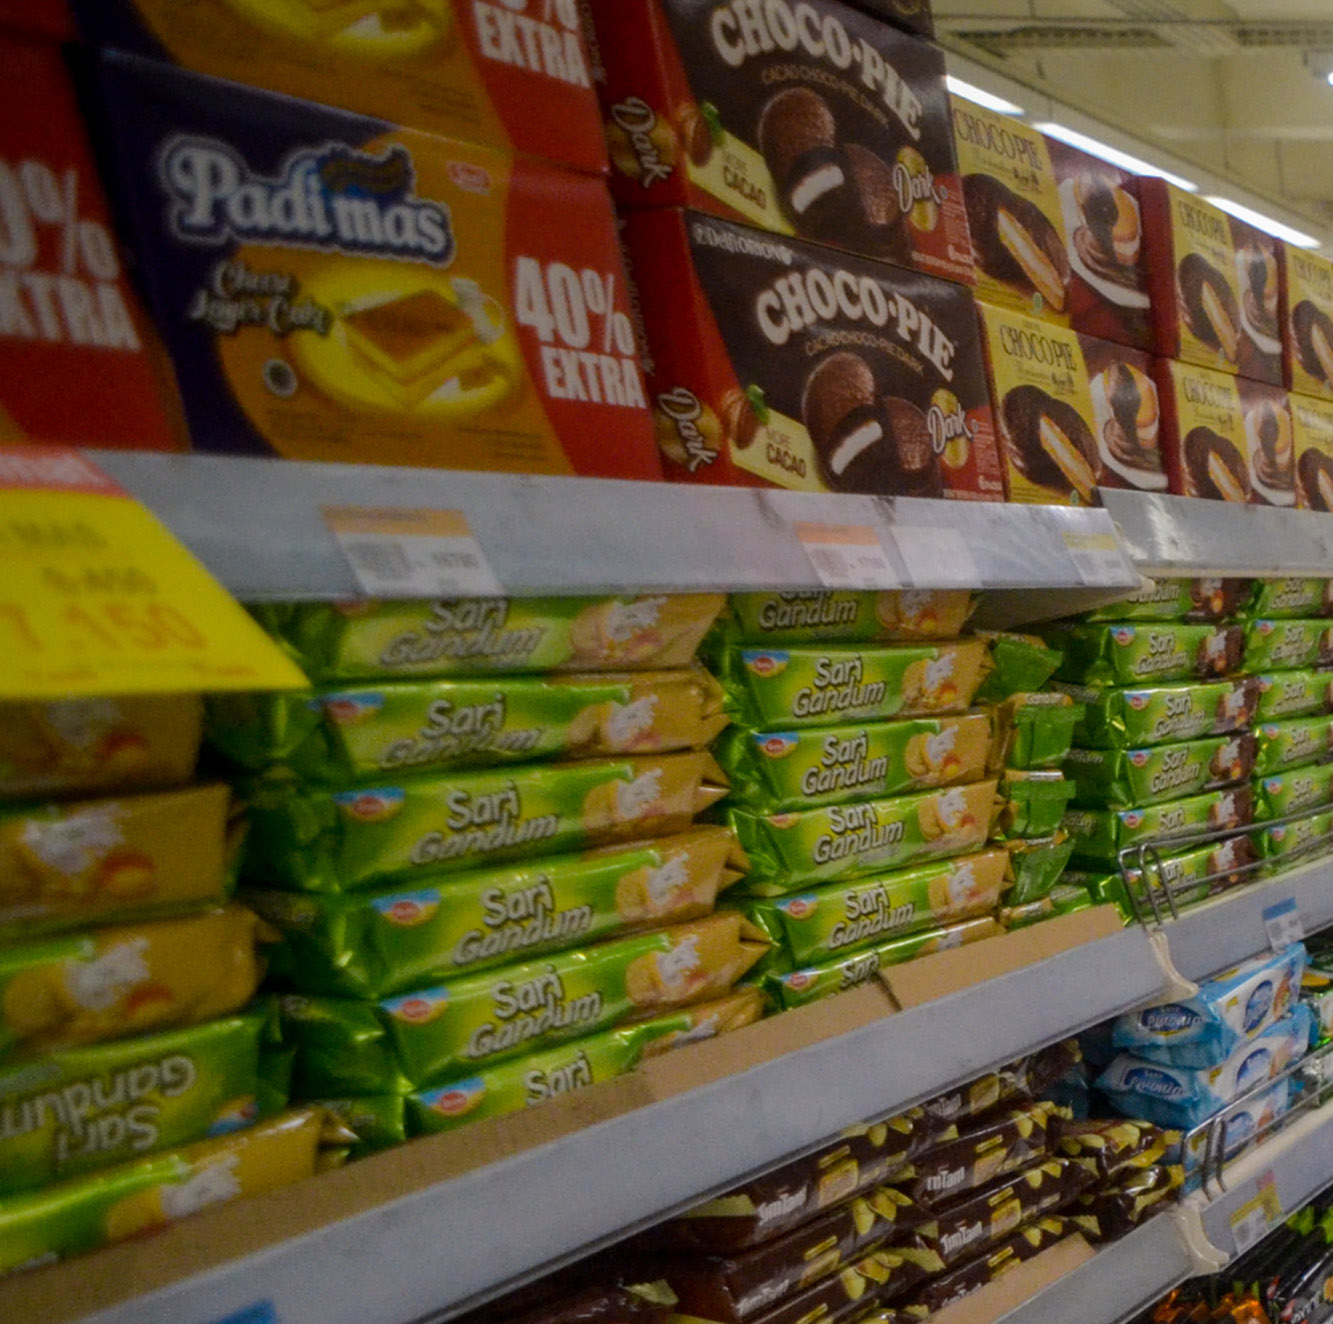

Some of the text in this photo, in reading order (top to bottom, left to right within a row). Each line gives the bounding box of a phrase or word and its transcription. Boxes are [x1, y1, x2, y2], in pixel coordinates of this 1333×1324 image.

[475, 8, 592, 89] EXTRA
[893, 162, 944, 213] Dark
[515, 255, 635, 352] 40%
[541, 345, 646, 408] EXTRA
[661, 387, 718, 471] Dark
[928, 405, 974, 456] Dark
[766, 445, 807, 478] CACAO
[758, 602, 857, 630] Gandum
[813, 654, 862, 688] Sari
[424, 693, 505, 736] Sari
[793, 678, 886, 718] Gandum
[821, 731, 867, 765] Sari
[802, 755, 888, 796] Gandum
[446, 779, 520, 832] Sari
[409, 813, 559, 866] Gandum
[813, 821, 904, 864] Gandum
[481, 873, 554, 929] Sari
[828, 903, 914, 951] Gandum
[451, 902, 591, 967] Gandum
[492, 965, 559, 1020] Sari
[466, 988, 601, 1060] Gandum
[524, 1050, 592, 1106] Sari
